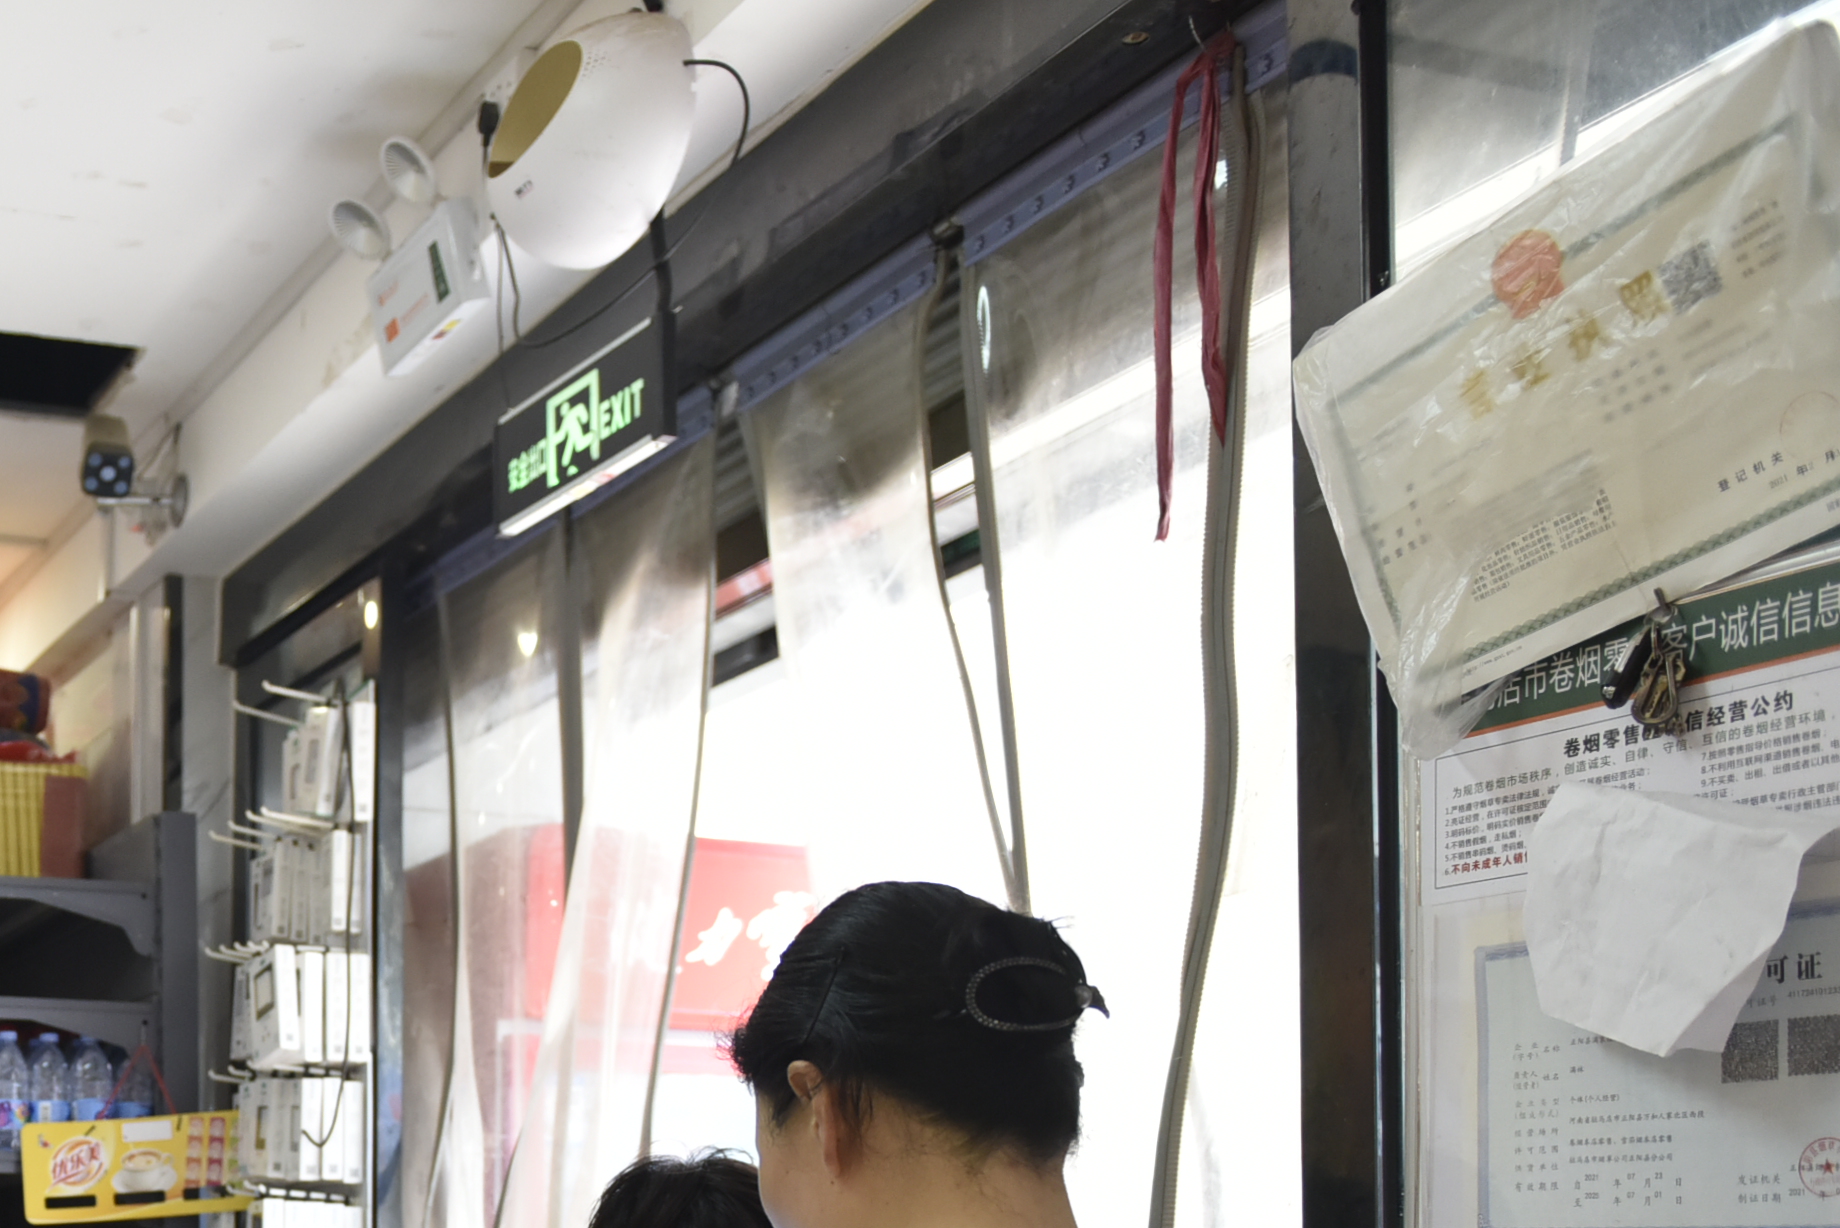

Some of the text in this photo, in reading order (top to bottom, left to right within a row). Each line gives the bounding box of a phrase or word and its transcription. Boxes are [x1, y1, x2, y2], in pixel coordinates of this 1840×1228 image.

[599, 377, 645, 441] EXIT
[1444, 851, 1528, 877] 6.不向未成年人销
